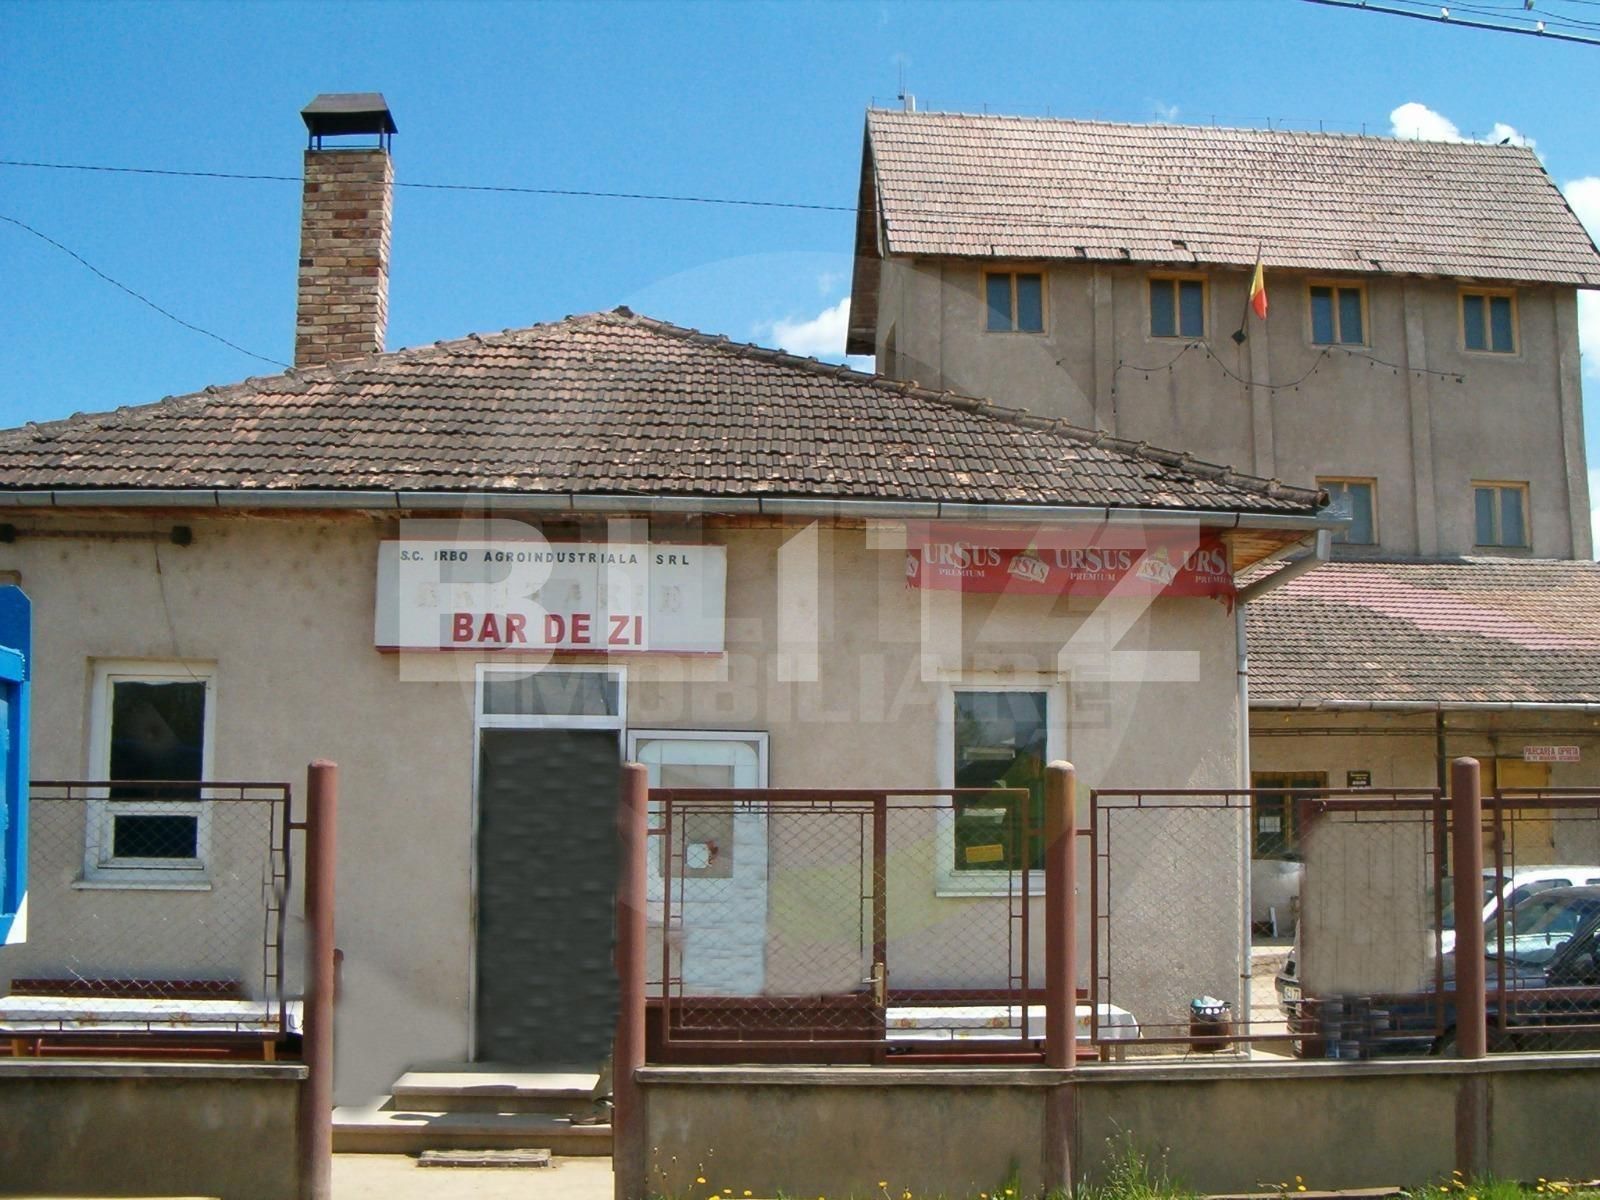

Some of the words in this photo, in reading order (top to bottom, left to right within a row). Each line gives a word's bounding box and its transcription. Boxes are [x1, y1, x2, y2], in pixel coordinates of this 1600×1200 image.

[400, 550, 424, 563] S.C.
[433, 550, 469, 562] IRBO
[483, 550, 639, 566] AGROINDUSTRIALA
[655, 553, 690, 566] SRL
[923, 541, 1001, 569] URSUS
[1054, 545, 1132, 574] URSUS
[938, 567, 986, 578] PREMIUM
[1069, 571, 1117, 582] PREMIUM
[452, 612, 528, 644] BAR
[543, 613, 592, 645] DE
[607, 615, 644, 646] ZI
